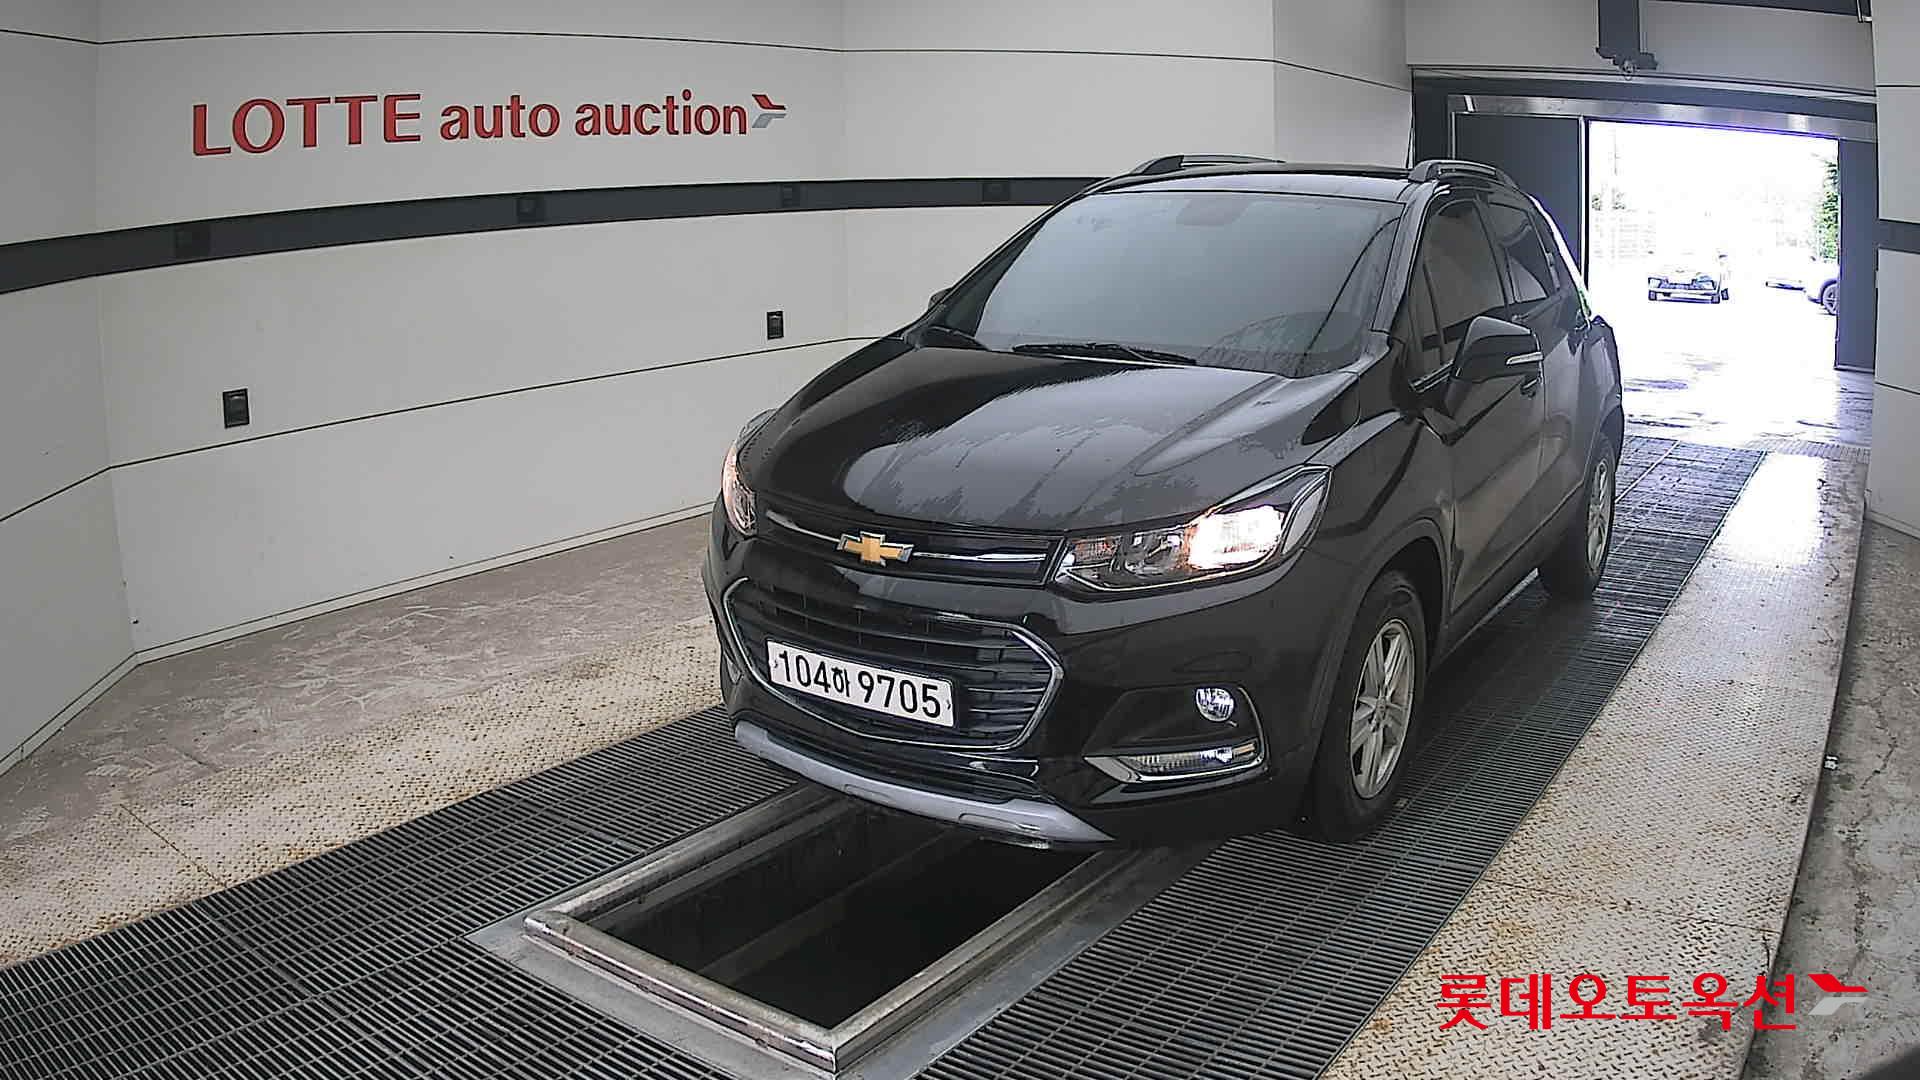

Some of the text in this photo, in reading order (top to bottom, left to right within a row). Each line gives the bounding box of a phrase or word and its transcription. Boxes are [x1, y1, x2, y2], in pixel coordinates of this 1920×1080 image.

[192, 88, 748, 157] LOTTE auto auction
[778, 650, 942, 718] 104하 9705
